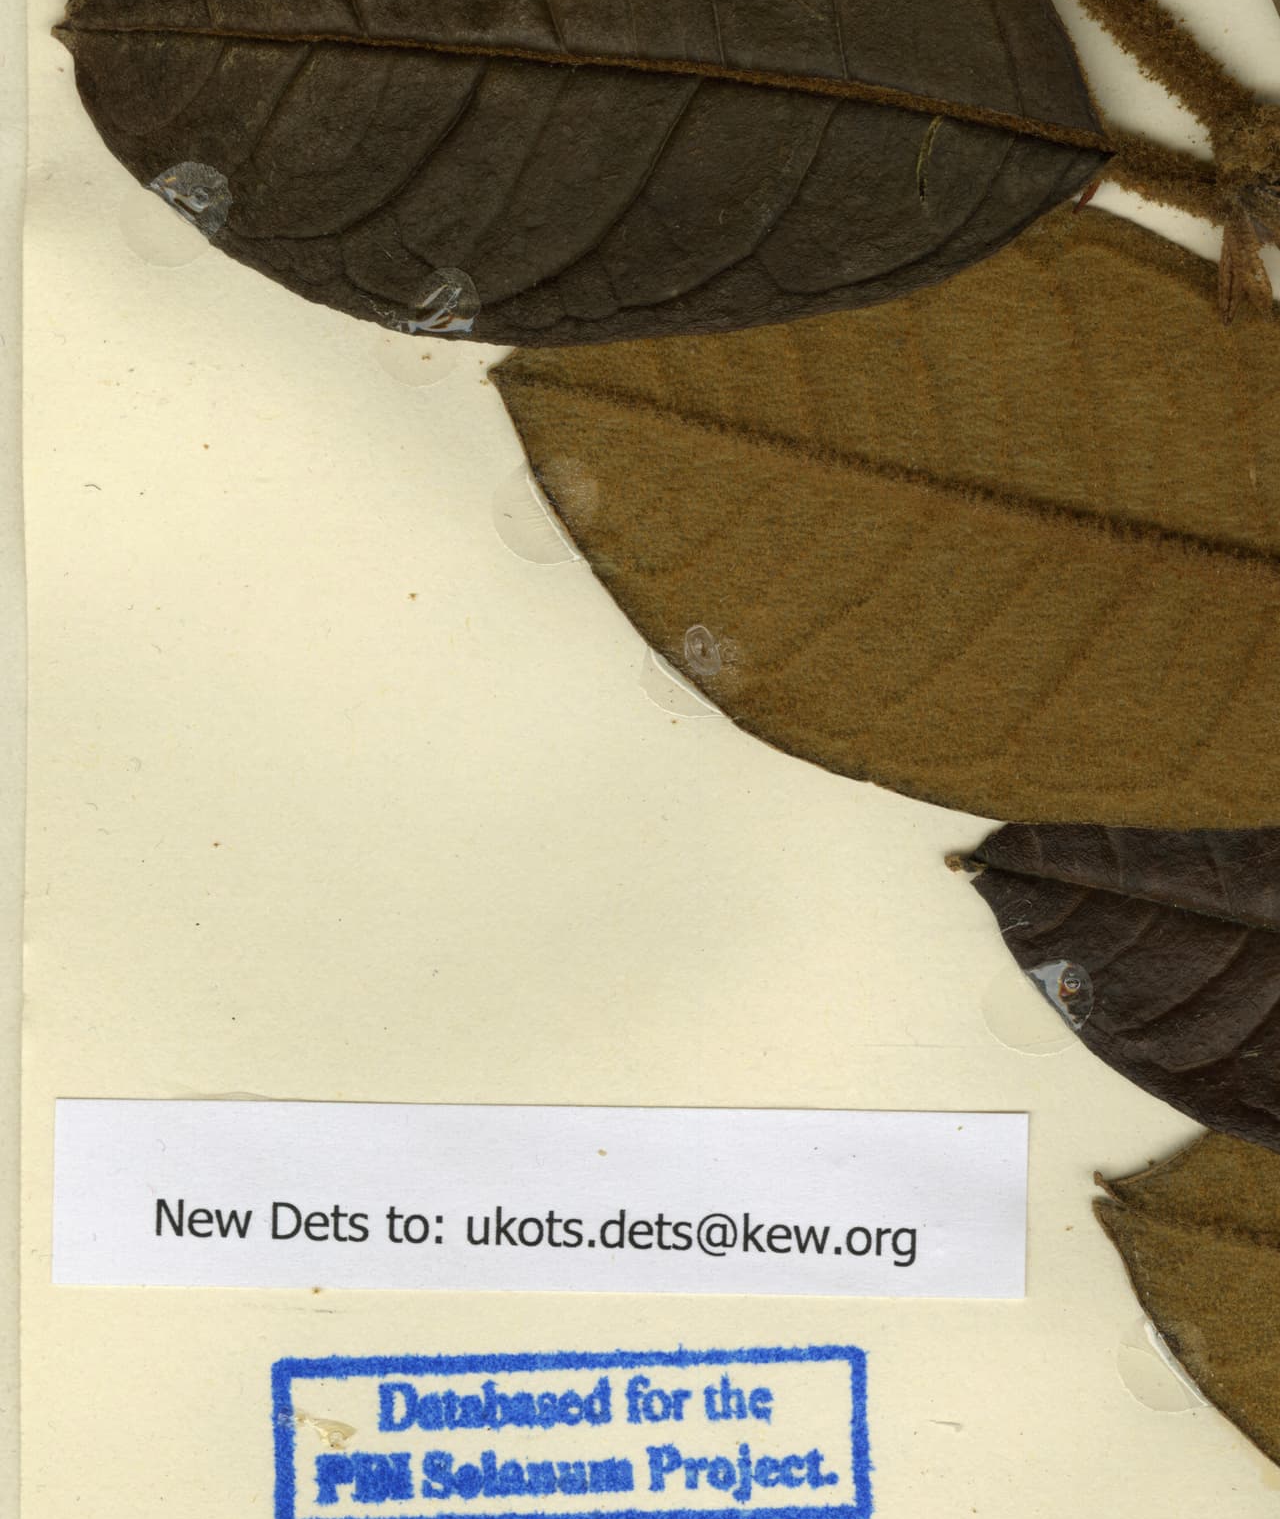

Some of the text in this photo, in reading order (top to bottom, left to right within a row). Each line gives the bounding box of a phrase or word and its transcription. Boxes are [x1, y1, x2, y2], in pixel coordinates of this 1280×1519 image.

[155, 1198, 917, 1268] New Dets to: ukots.dets@kew.org
[625, 1373, 692, 1425] for
[702, 1372, 775, 1425] the
[420, 1448, 634, 1500] Solanum
[646, 1443, 840, 1503] Project.
